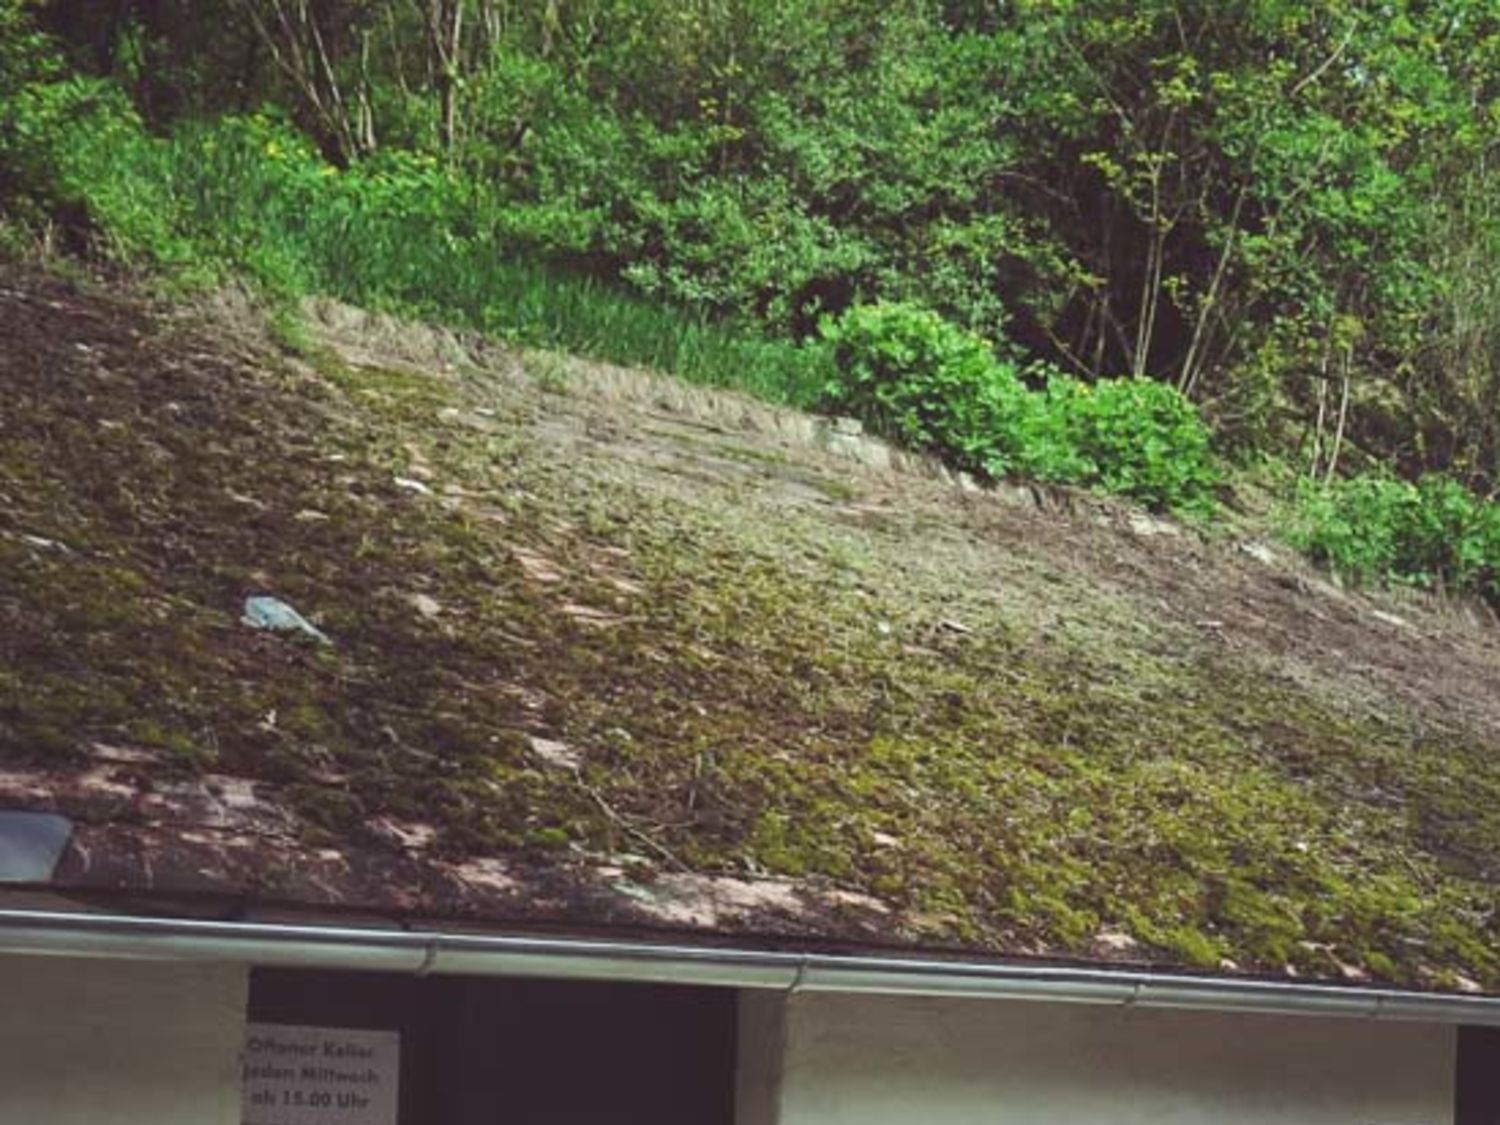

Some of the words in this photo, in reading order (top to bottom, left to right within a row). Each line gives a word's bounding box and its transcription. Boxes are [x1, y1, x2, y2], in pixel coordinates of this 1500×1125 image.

[322, 1039, 373, 1058] Keller
[301, 1066, 380, 1085] Mittwoch
[282, 1089, 332, 1107] 15.00
[336, 1090, 370, 1109] Uhr
